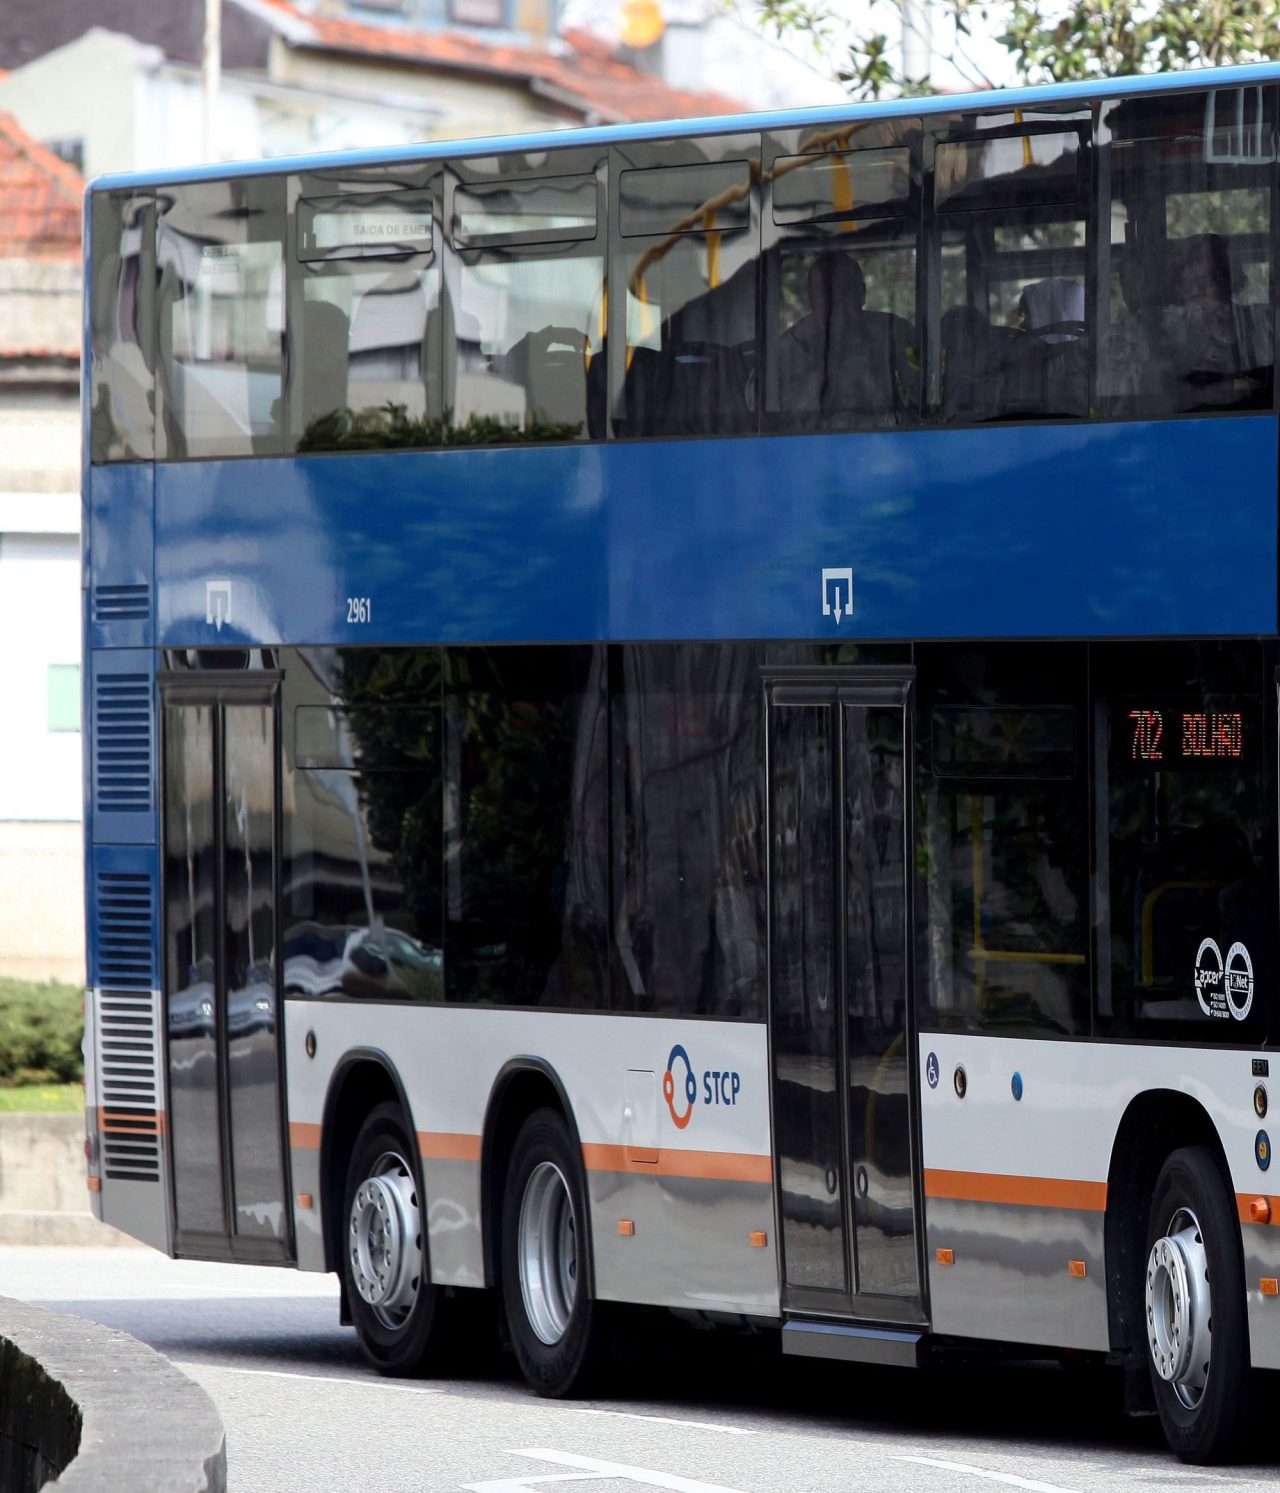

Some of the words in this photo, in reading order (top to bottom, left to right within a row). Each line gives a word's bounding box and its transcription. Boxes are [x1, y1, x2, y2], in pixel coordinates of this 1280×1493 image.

[346, 597, 371, 623] 2961
[1129, 710, 1163, 759] 702
[1252, 1060, 1267, 1073] EEV
[703, 1070, 740, 1105] STCP
